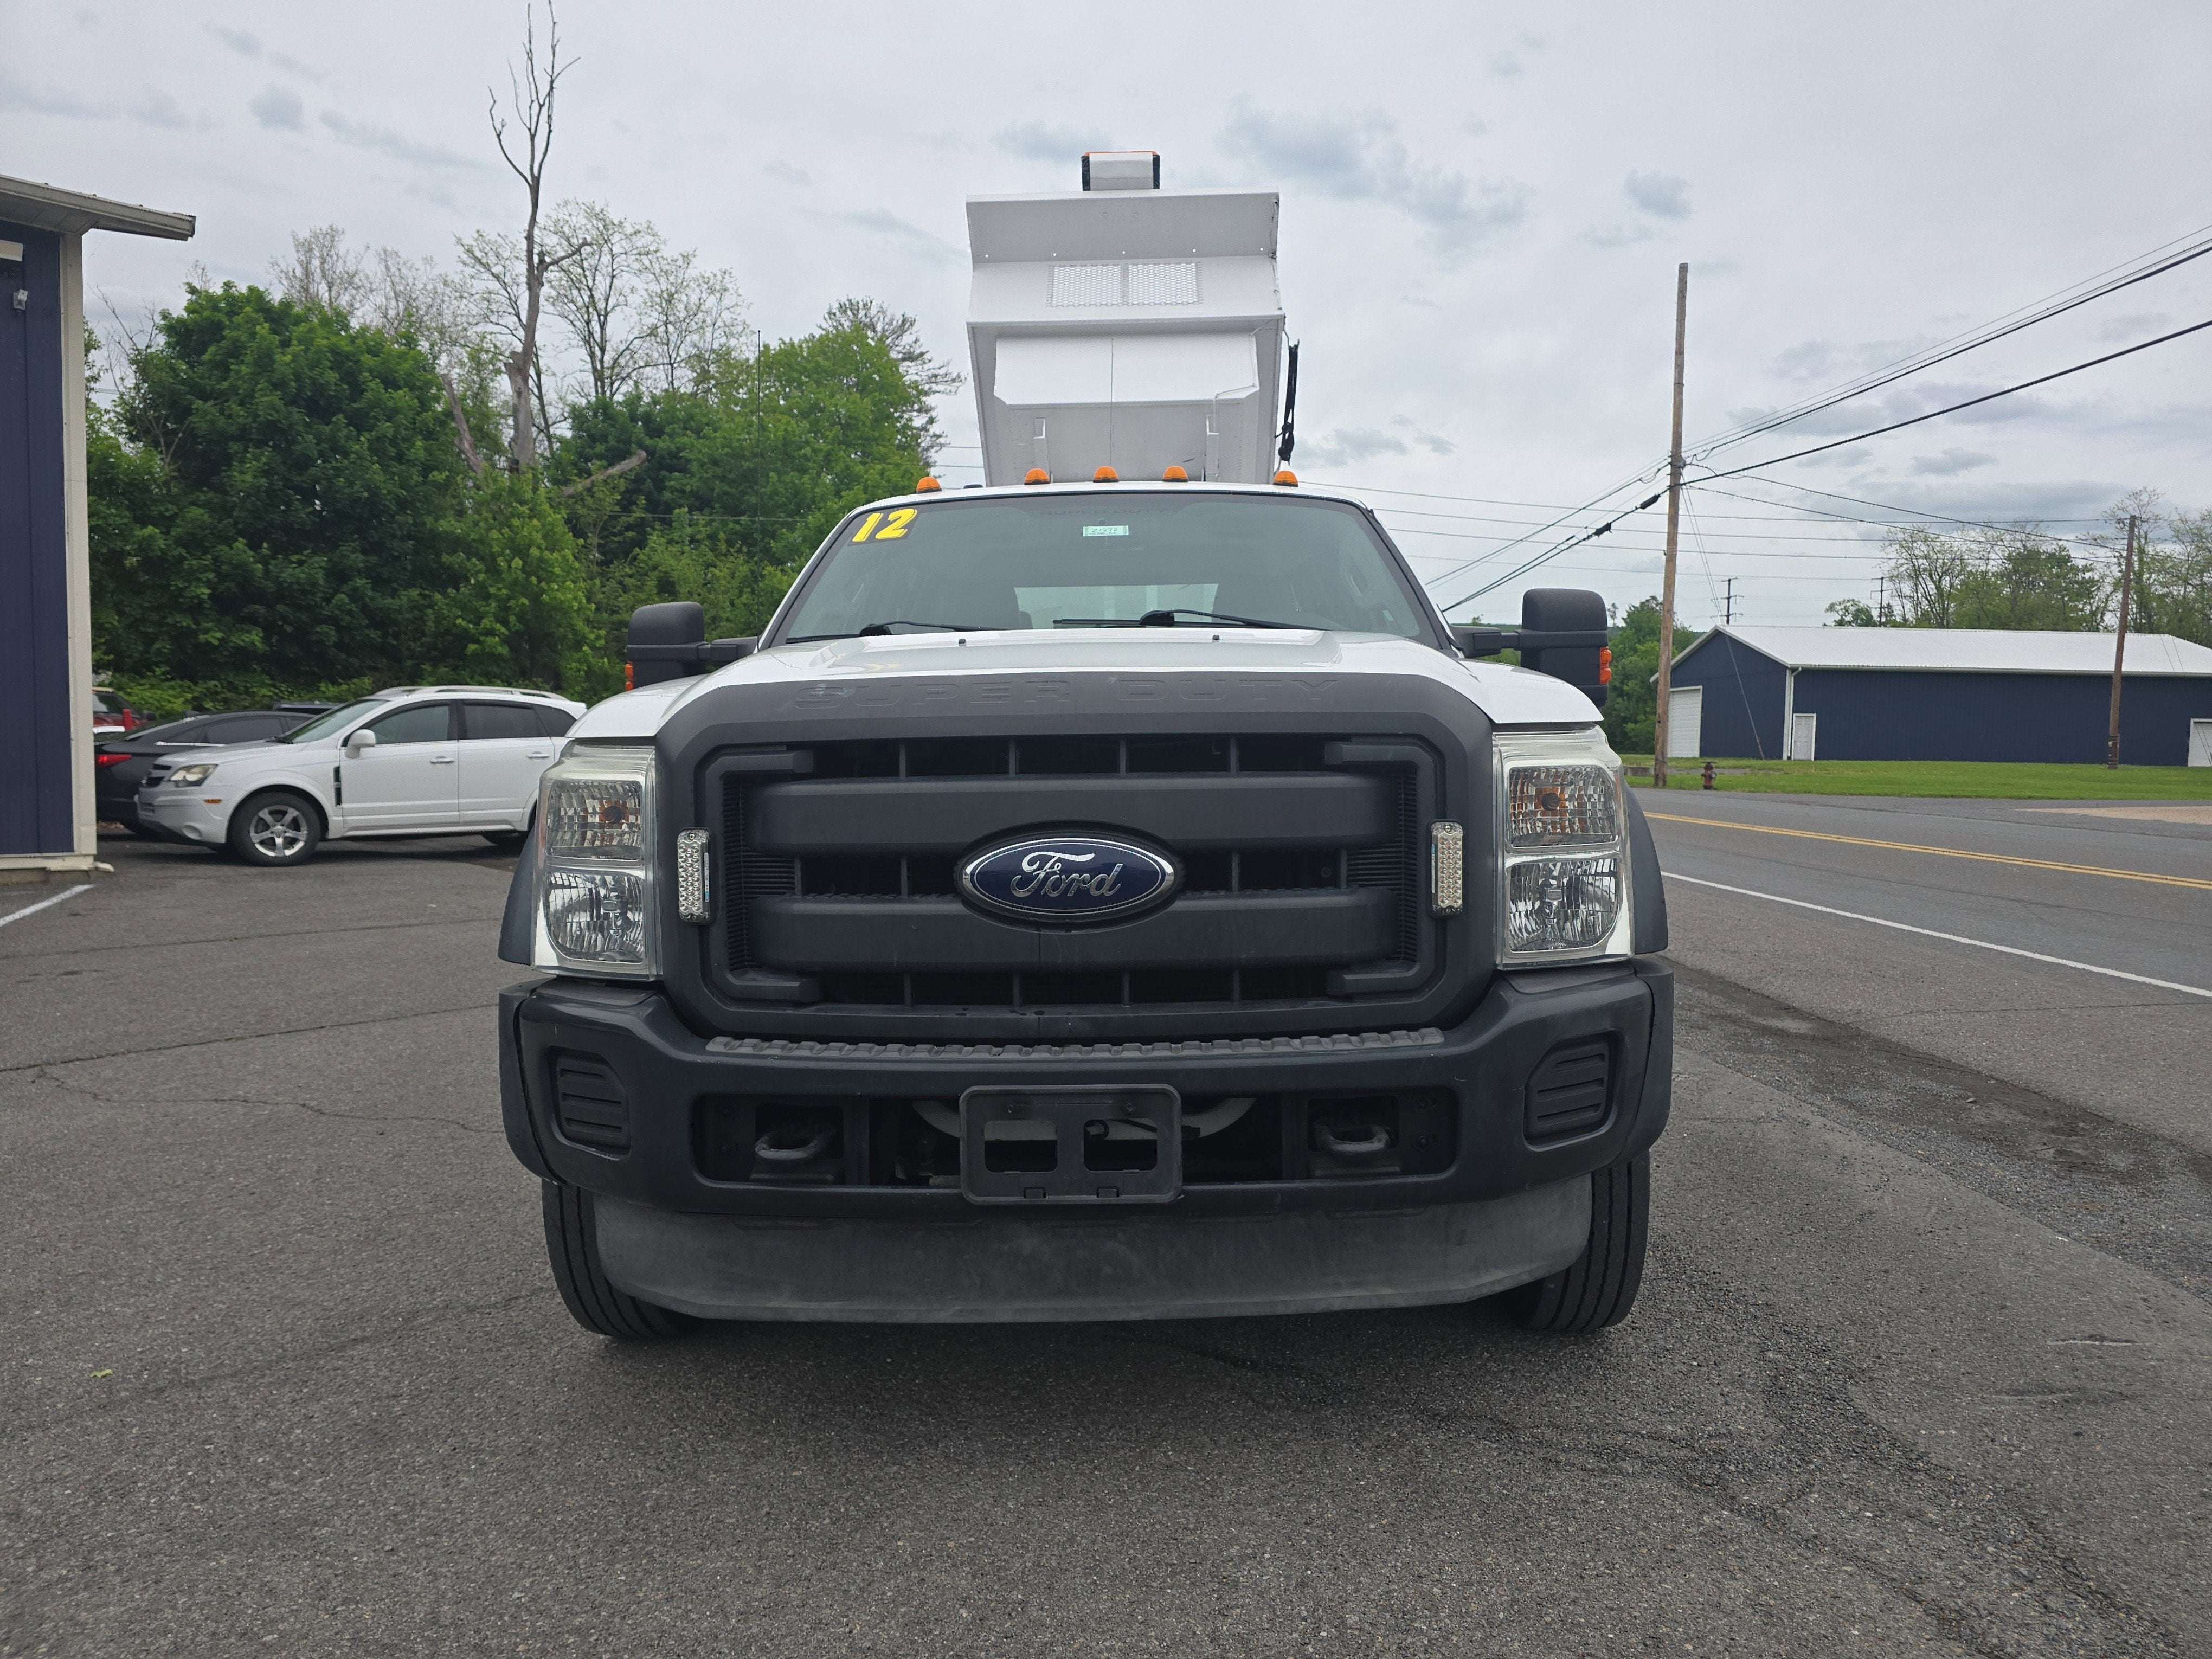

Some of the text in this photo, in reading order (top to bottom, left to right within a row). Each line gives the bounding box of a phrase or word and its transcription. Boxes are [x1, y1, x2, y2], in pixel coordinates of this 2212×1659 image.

[852, 508, 917, 542] 12
[794, 679, 1338, 709] SUPER DUTY
[1010, 851, 1124, 898] Ford
